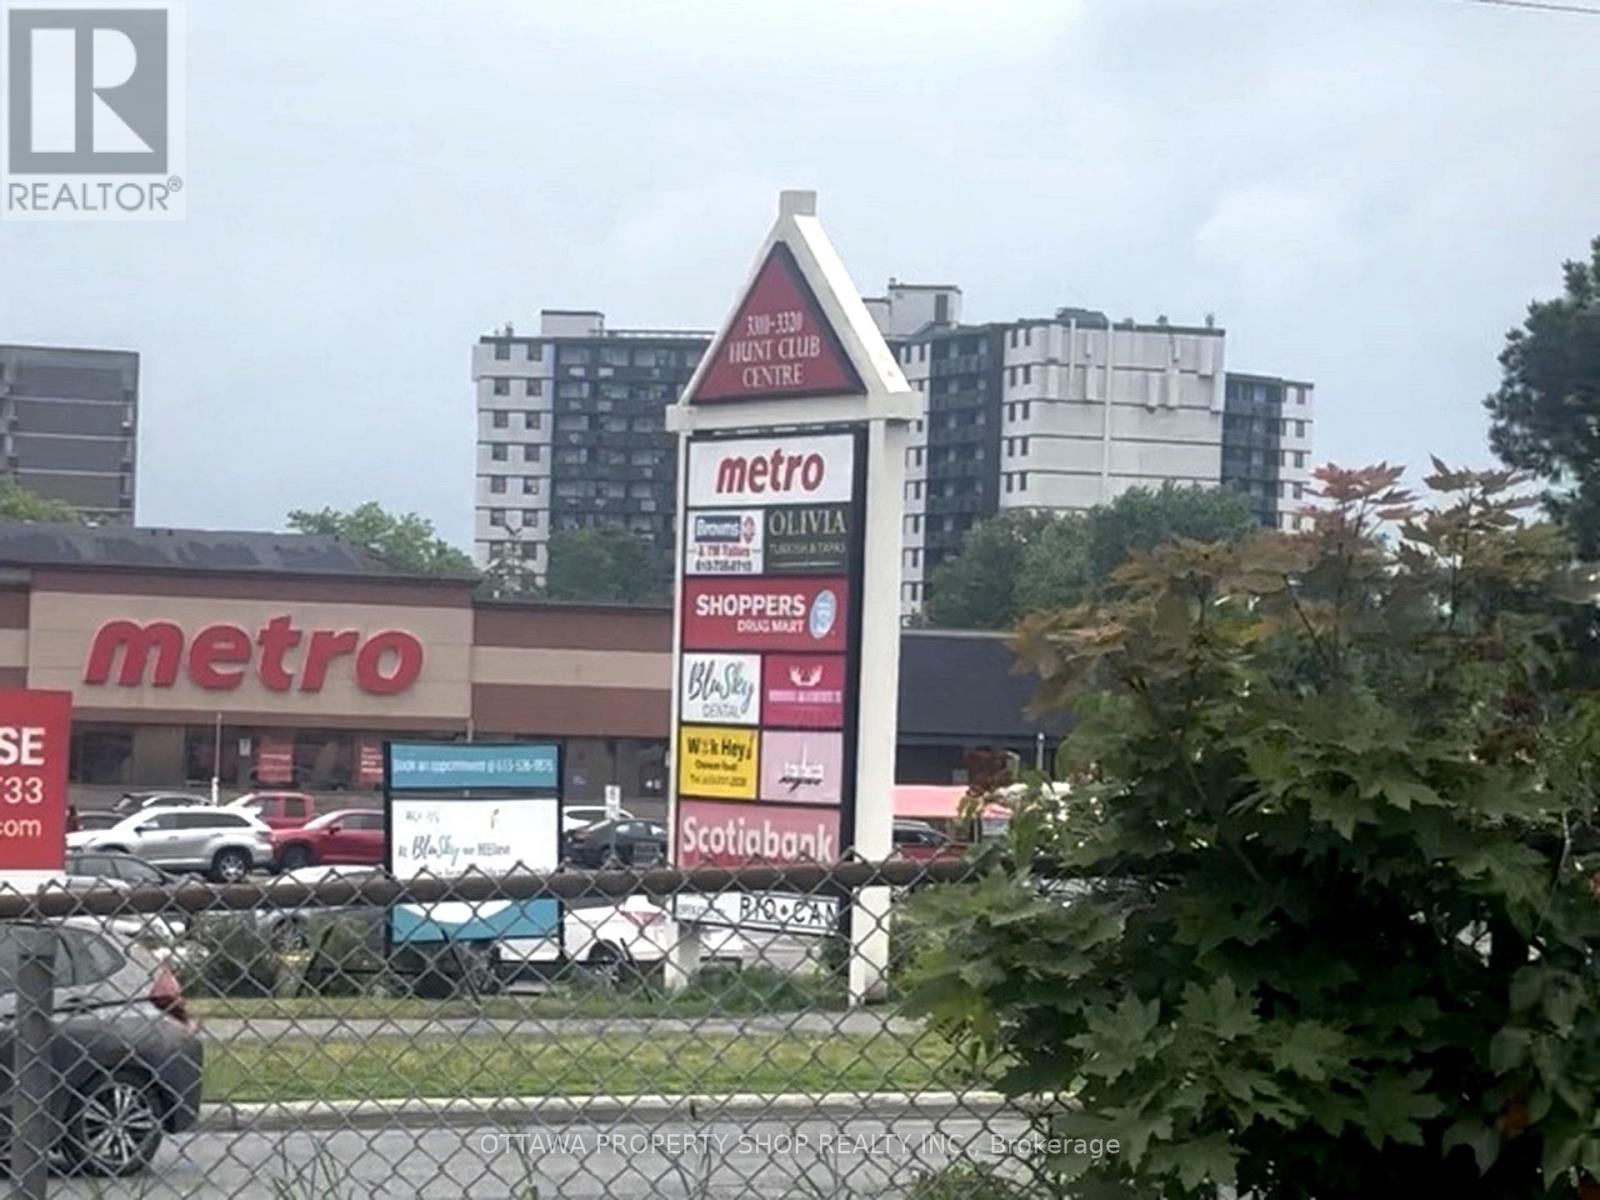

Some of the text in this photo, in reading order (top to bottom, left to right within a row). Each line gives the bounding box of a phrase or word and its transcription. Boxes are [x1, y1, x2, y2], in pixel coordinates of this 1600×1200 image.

[728, 335, 821, 364] HUNT CLUB
[742, 363, 804, 388] CENTRE
[716, 448, 825, 494] metro
[768, 509, 847, 536] OLIVIA
[696, 594, 806, 617] SHOPPERS
[737, 619, 806, 634] DRUG MART
[84, 614, 425, 696] metro
[683, 815, 834, 863] Scotiabank
